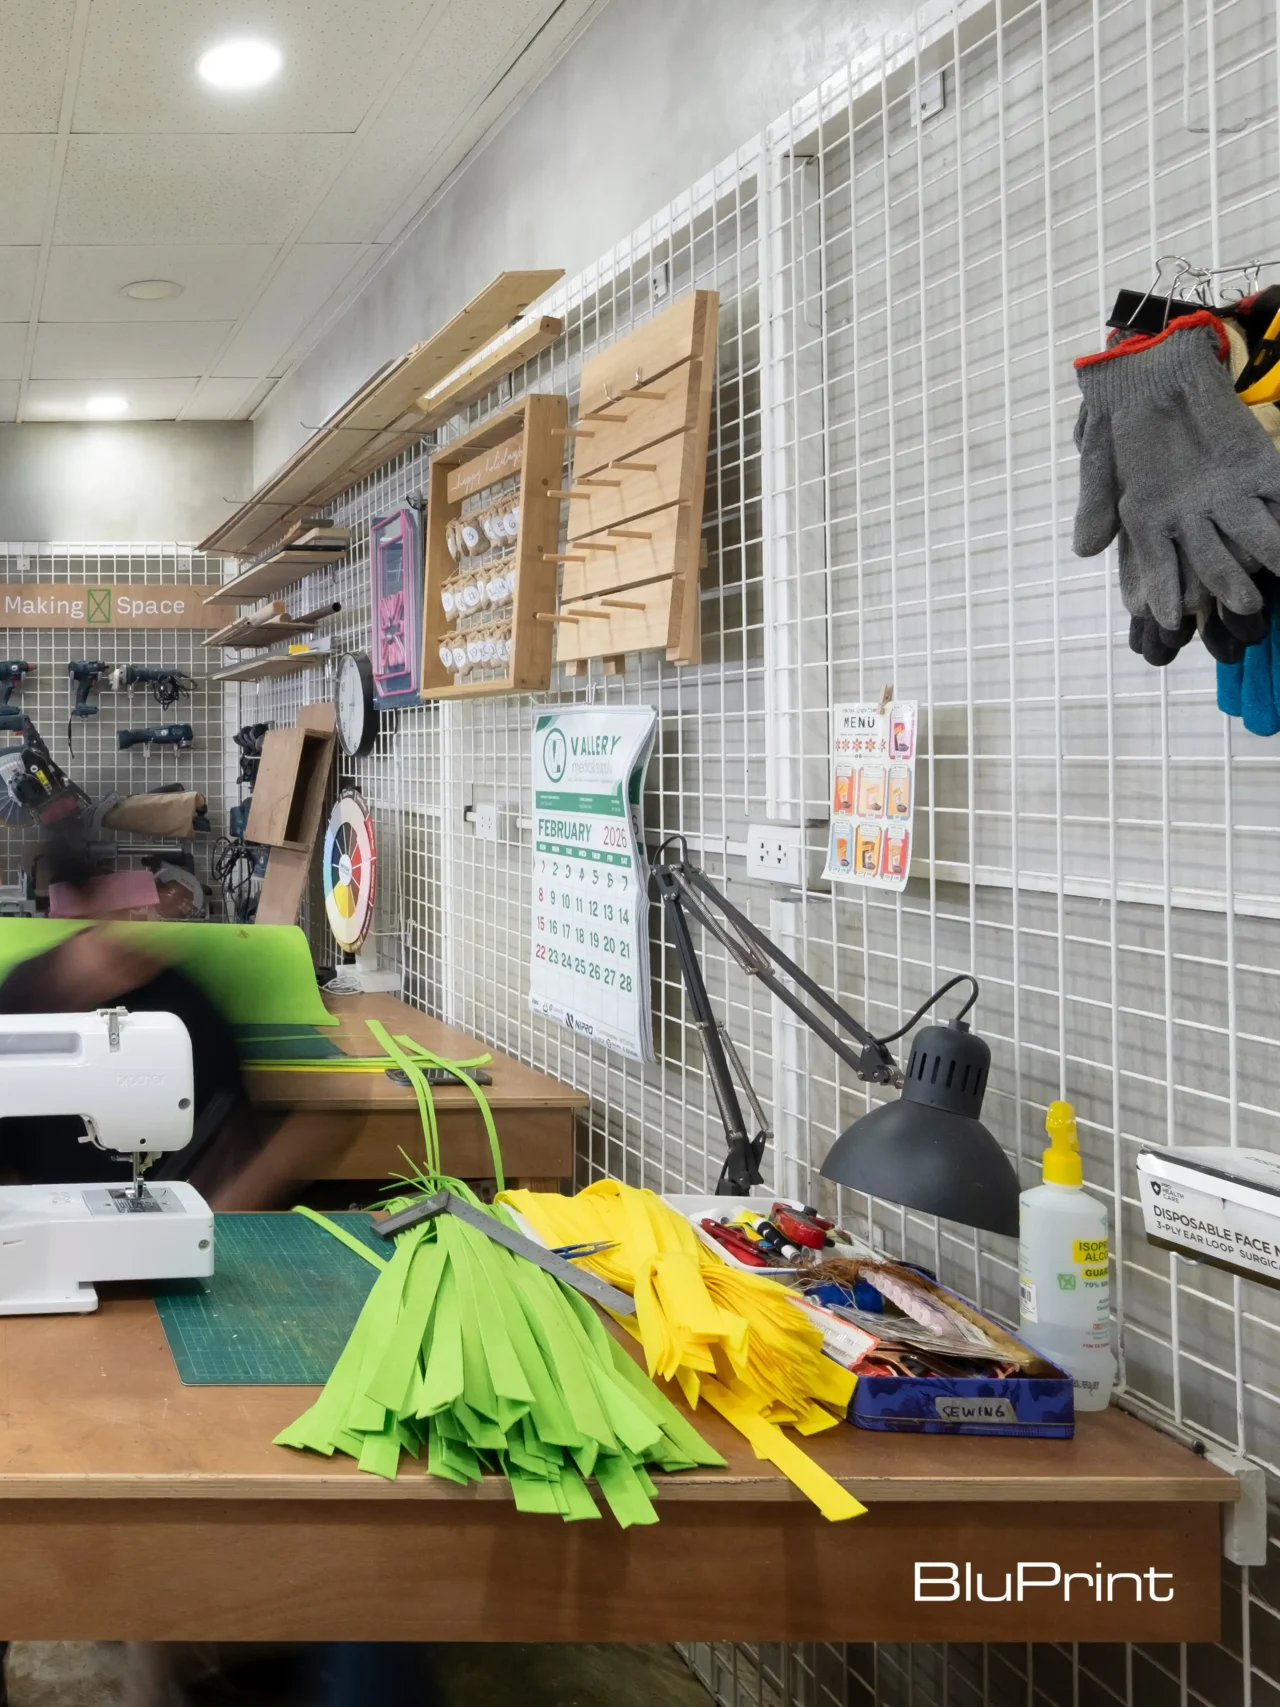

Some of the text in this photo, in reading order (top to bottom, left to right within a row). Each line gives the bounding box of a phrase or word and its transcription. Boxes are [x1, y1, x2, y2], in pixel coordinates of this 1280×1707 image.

[5, 596, 185, 619] Making Space
[538, 818, 627, 848] FEBRUARY 2026
[552, 862, 558, 876] 2
[566, 864, 572, 878] 3
[579, 868, 584, 882] 4
[592, 870, 599, 884] 5
[608, 872, 614, 888] 6
[621, 875, 628, 891] 7
[538, 888, 629, 926] 8 9 10 11 12 13 14
[537, 916, 630, 959] 15 16 17 18 19 20 21
[536, 944, 632, 992] 22 23 24 25 26 27 28
[574, 1020, 594, 1035] NIPRO
[116, 1071, 167, 1087] brother
[1162, 1188, 1184, 1199] HEALTH
[1162, 1194, 1179, 1204] CARE
[1154, 1205, 1232, 1241] DISPOSABLE
[1234, 1232, 1271, 1255] FACE
[1156, 1221, 1182, 1235] 3-PLY
[1184, 1231, 1204, 1244] EAR
[1206, 1238, 1234, 1253] LOOP
[1239, 1250, 1280, 1270] SURGIC
[942, 1405, 1005, 1418] SEWING
